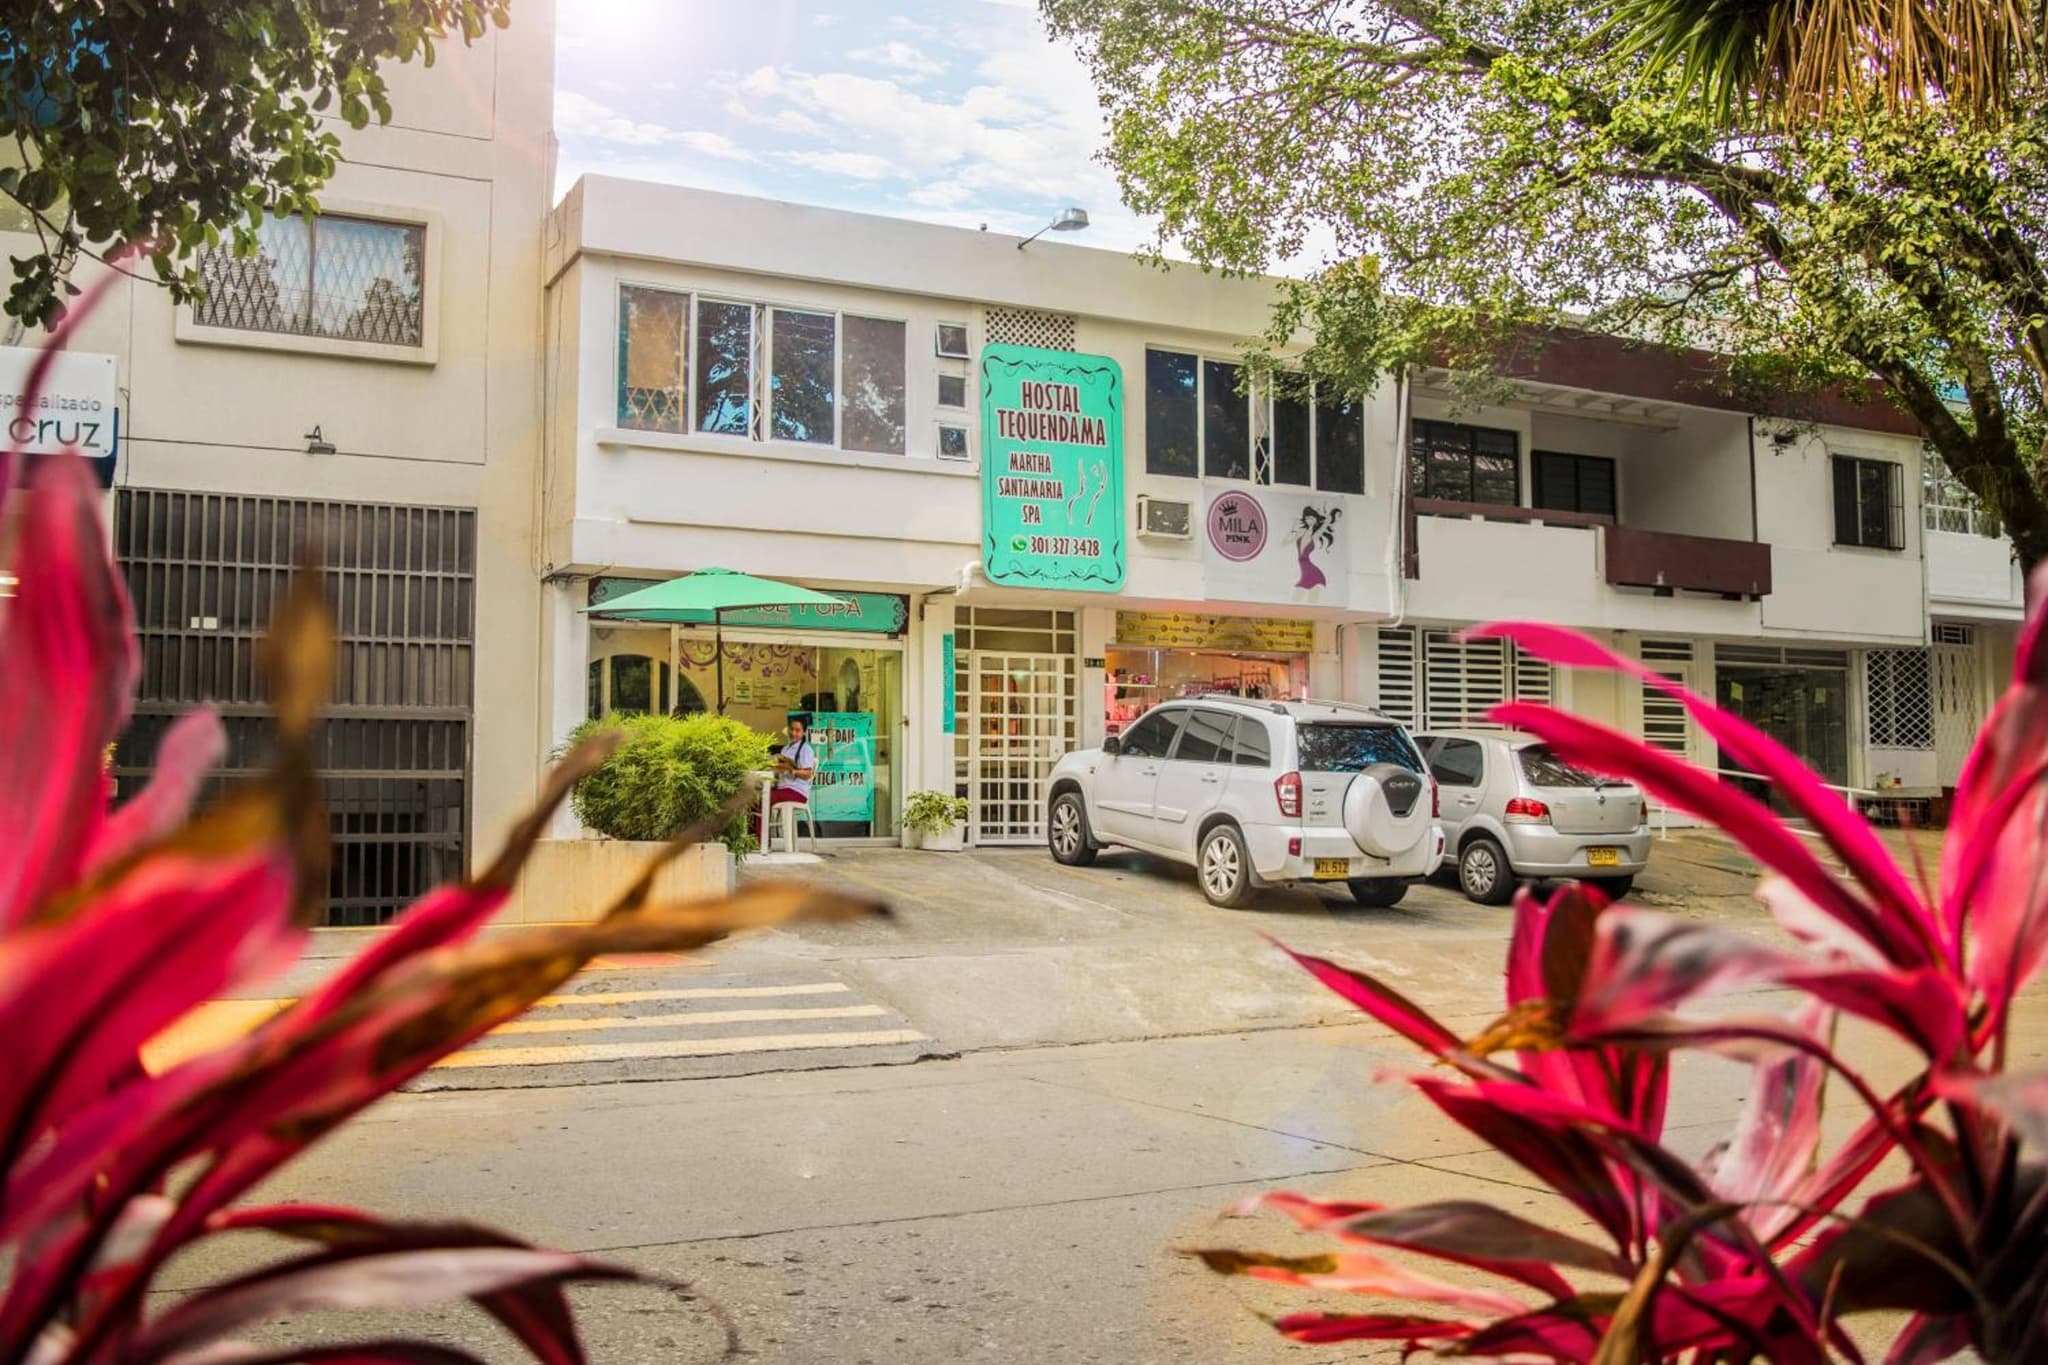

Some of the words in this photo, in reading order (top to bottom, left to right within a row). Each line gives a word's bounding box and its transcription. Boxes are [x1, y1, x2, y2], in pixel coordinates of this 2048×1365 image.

[1021, 381, 1081, 413] HOSTAL
[9, 417, 101, 448] cruz
[997, 409, 1106, 446] TEQUENDAMA
[1009, 452, 1052, 474] MARTHA
[998, 477, 1063, 500] SANTAMARIA
[1022, 504, 1041, 524] SPA
[1219, 517, 1259, 534] MILA
[1031, 535, 1049, 554] 301
[1053, 536, 1070, 555] 327
[1073, 538, 1100, 557] 3428
[1225, 534, 1251, 544] PINK
